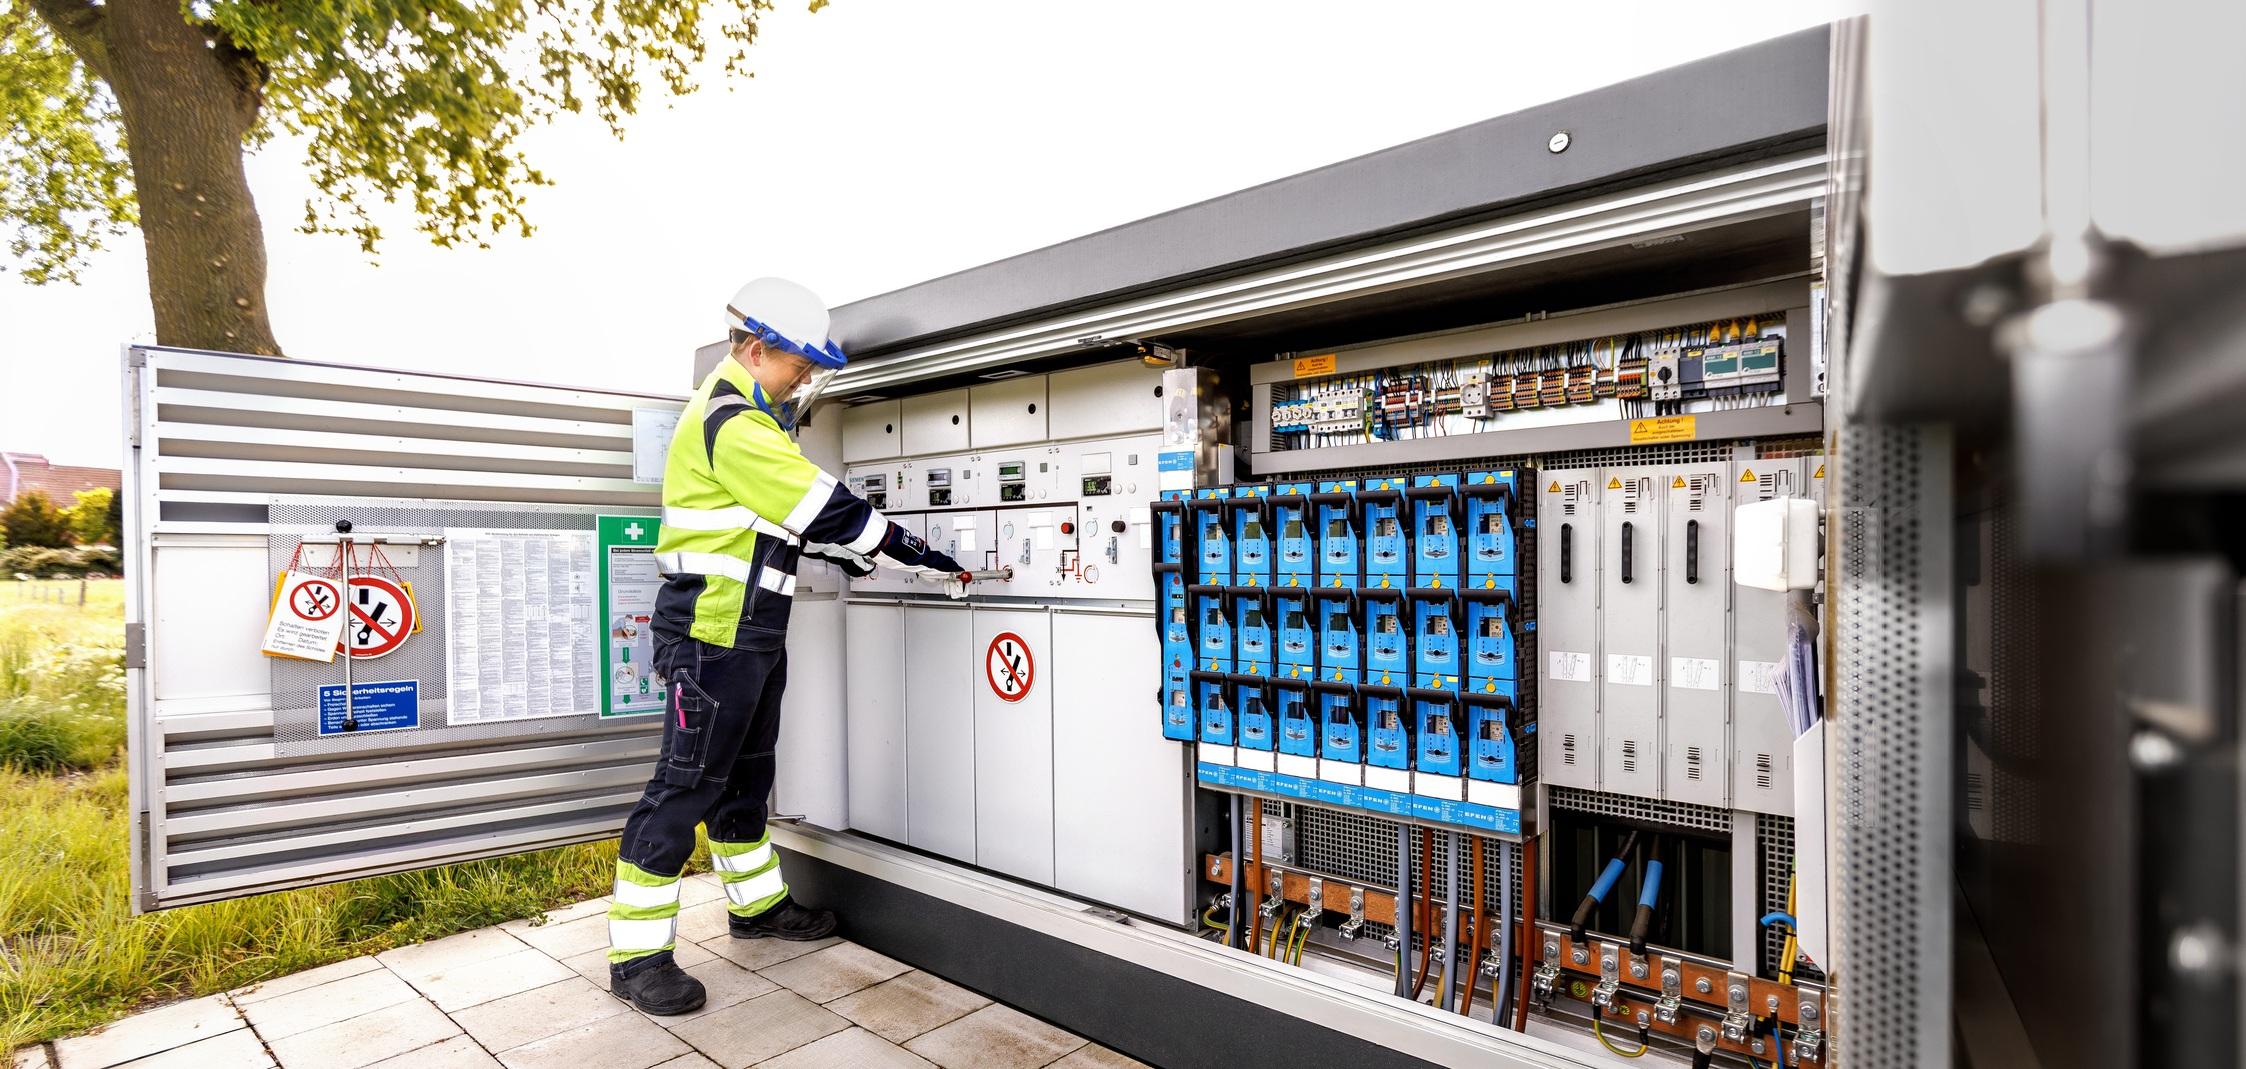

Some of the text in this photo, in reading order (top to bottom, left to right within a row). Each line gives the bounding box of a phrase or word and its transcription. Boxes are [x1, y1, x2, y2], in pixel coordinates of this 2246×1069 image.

[333, 686, 413, 696] Sicerheitsregeln
[1276, 781, 1293, 789] EFEN
[1318, 788, 1337, 796] EFEN
[1364, 795, 1383, 804] EFEN
[1413, 803, 1433, 811] EFEN
[1465, 811, 1487, 820] EFEN
